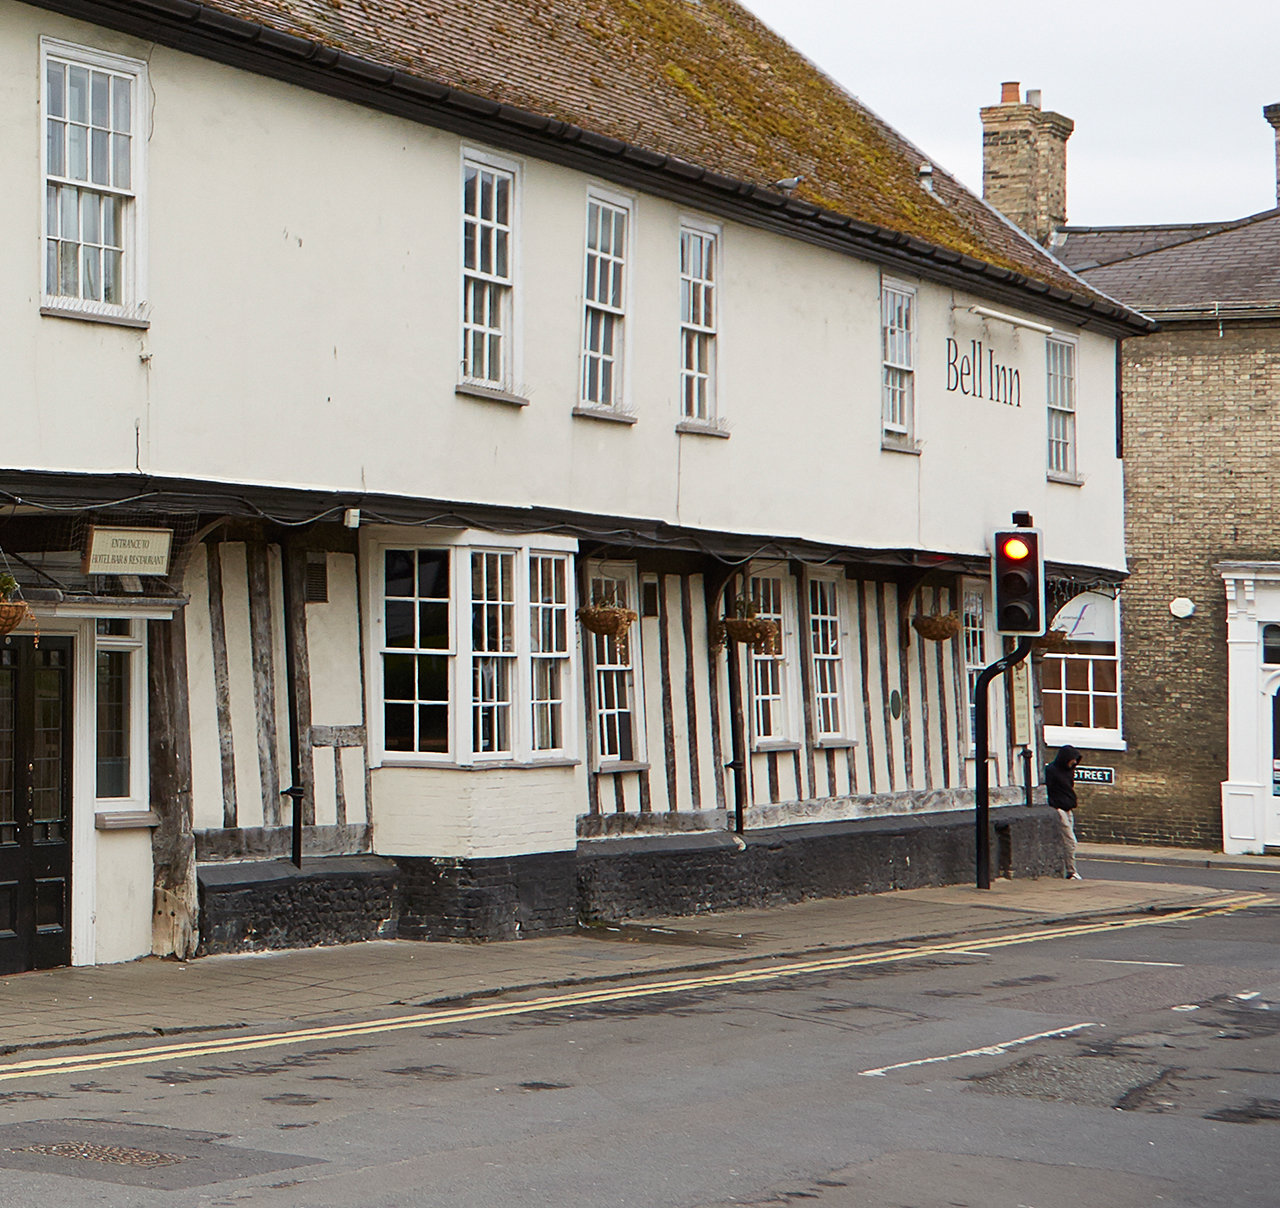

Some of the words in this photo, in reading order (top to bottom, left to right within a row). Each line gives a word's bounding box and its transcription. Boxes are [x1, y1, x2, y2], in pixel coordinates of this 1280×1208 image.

[946, 337, 983, 398] Bell
[988, 348, 1021, 408] Inn
[111, 539, 141, 548] ENTRANCE
[142, 540, 150, 549] TO
[92, 554, 110, 564] HOTEL
[128, 555, 165, 565] RESTAURANT
[1073, 769, 1111, 781] STREET
